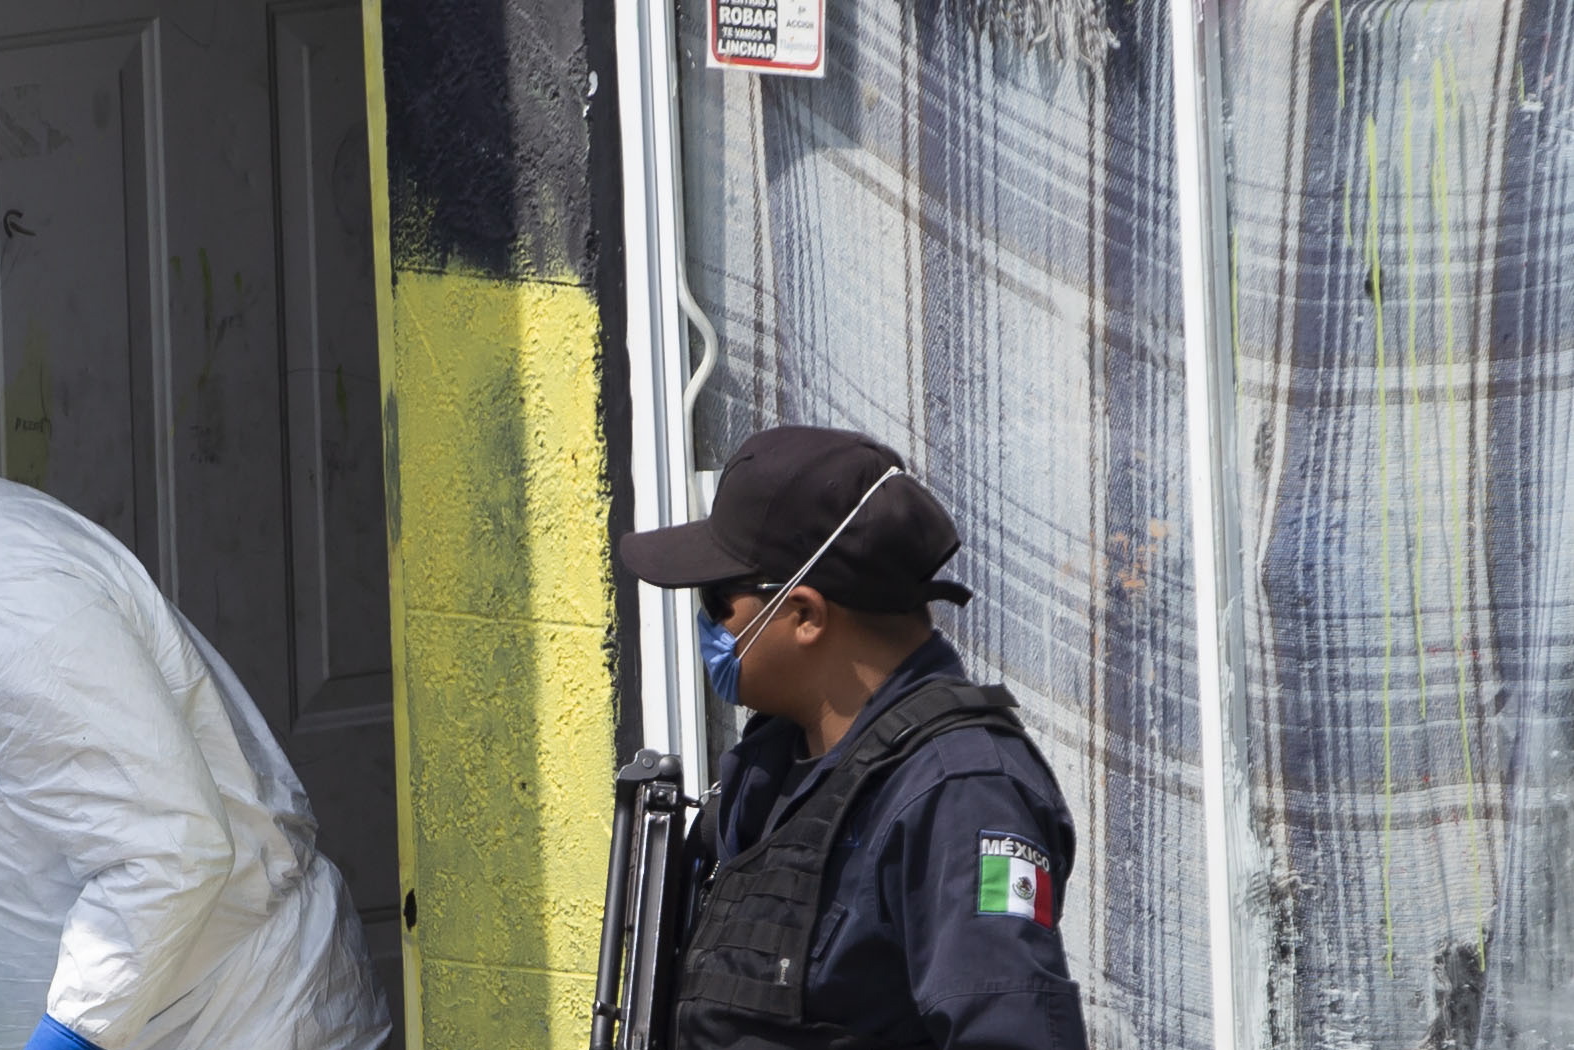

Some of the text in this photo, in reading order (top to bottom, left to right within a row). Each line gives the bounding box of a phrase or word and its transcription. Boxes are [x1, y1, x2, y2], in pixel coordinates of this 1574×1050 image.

[718, 6, 777, 29] ROBAR
[722, 26, 772, 42] TE VAMOS A
[717, 39, 776, 58] LINCHAR
[982, 837, 1050, 872] MÉXICO
